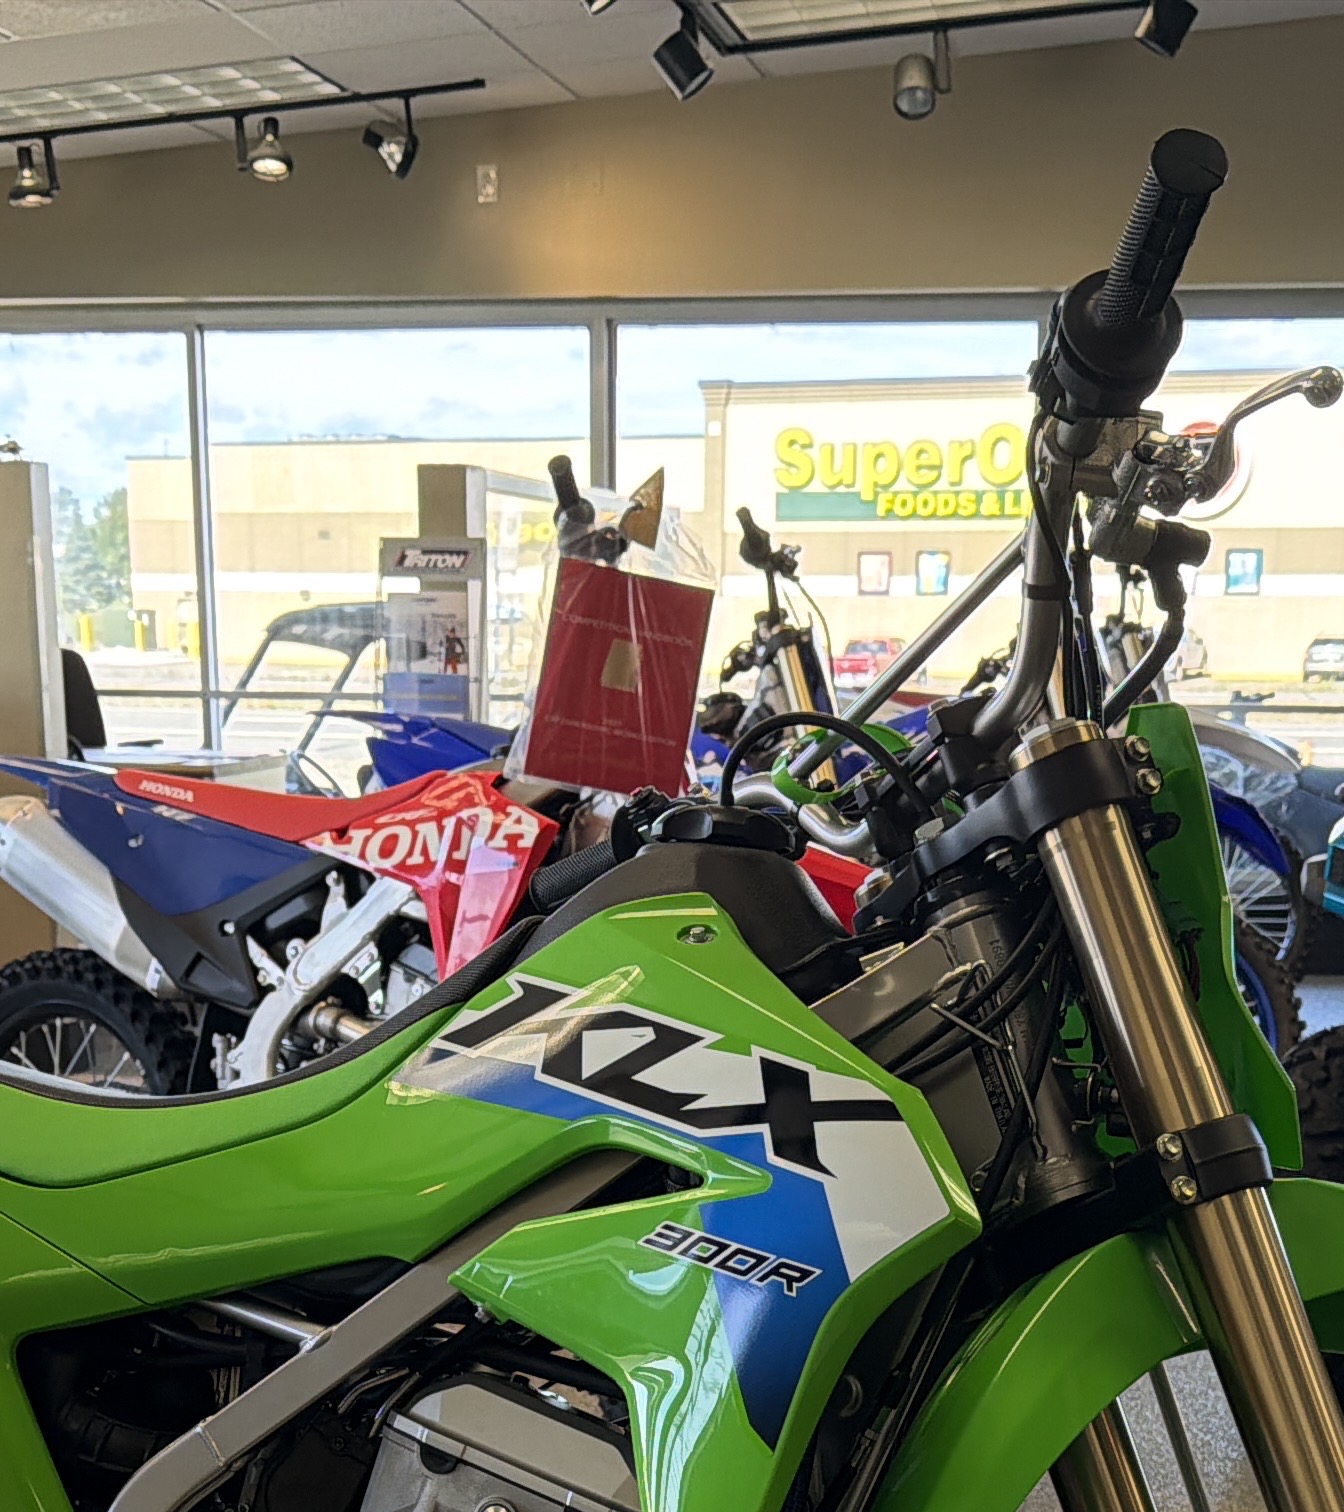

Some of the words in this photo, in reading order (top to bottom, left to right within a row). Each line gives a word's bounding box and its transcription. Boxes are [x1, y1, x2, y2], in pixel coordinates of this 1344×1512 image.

[877, 492, 976, 517] FOODS
[980, 491, 1000, 515] &
[402, 549, 467, 569] TRITON
[138, 779, 194, 803] HONDA
[306, 805, 540, 870] HONDA
[640, 1222, 820, 1296] 300R
